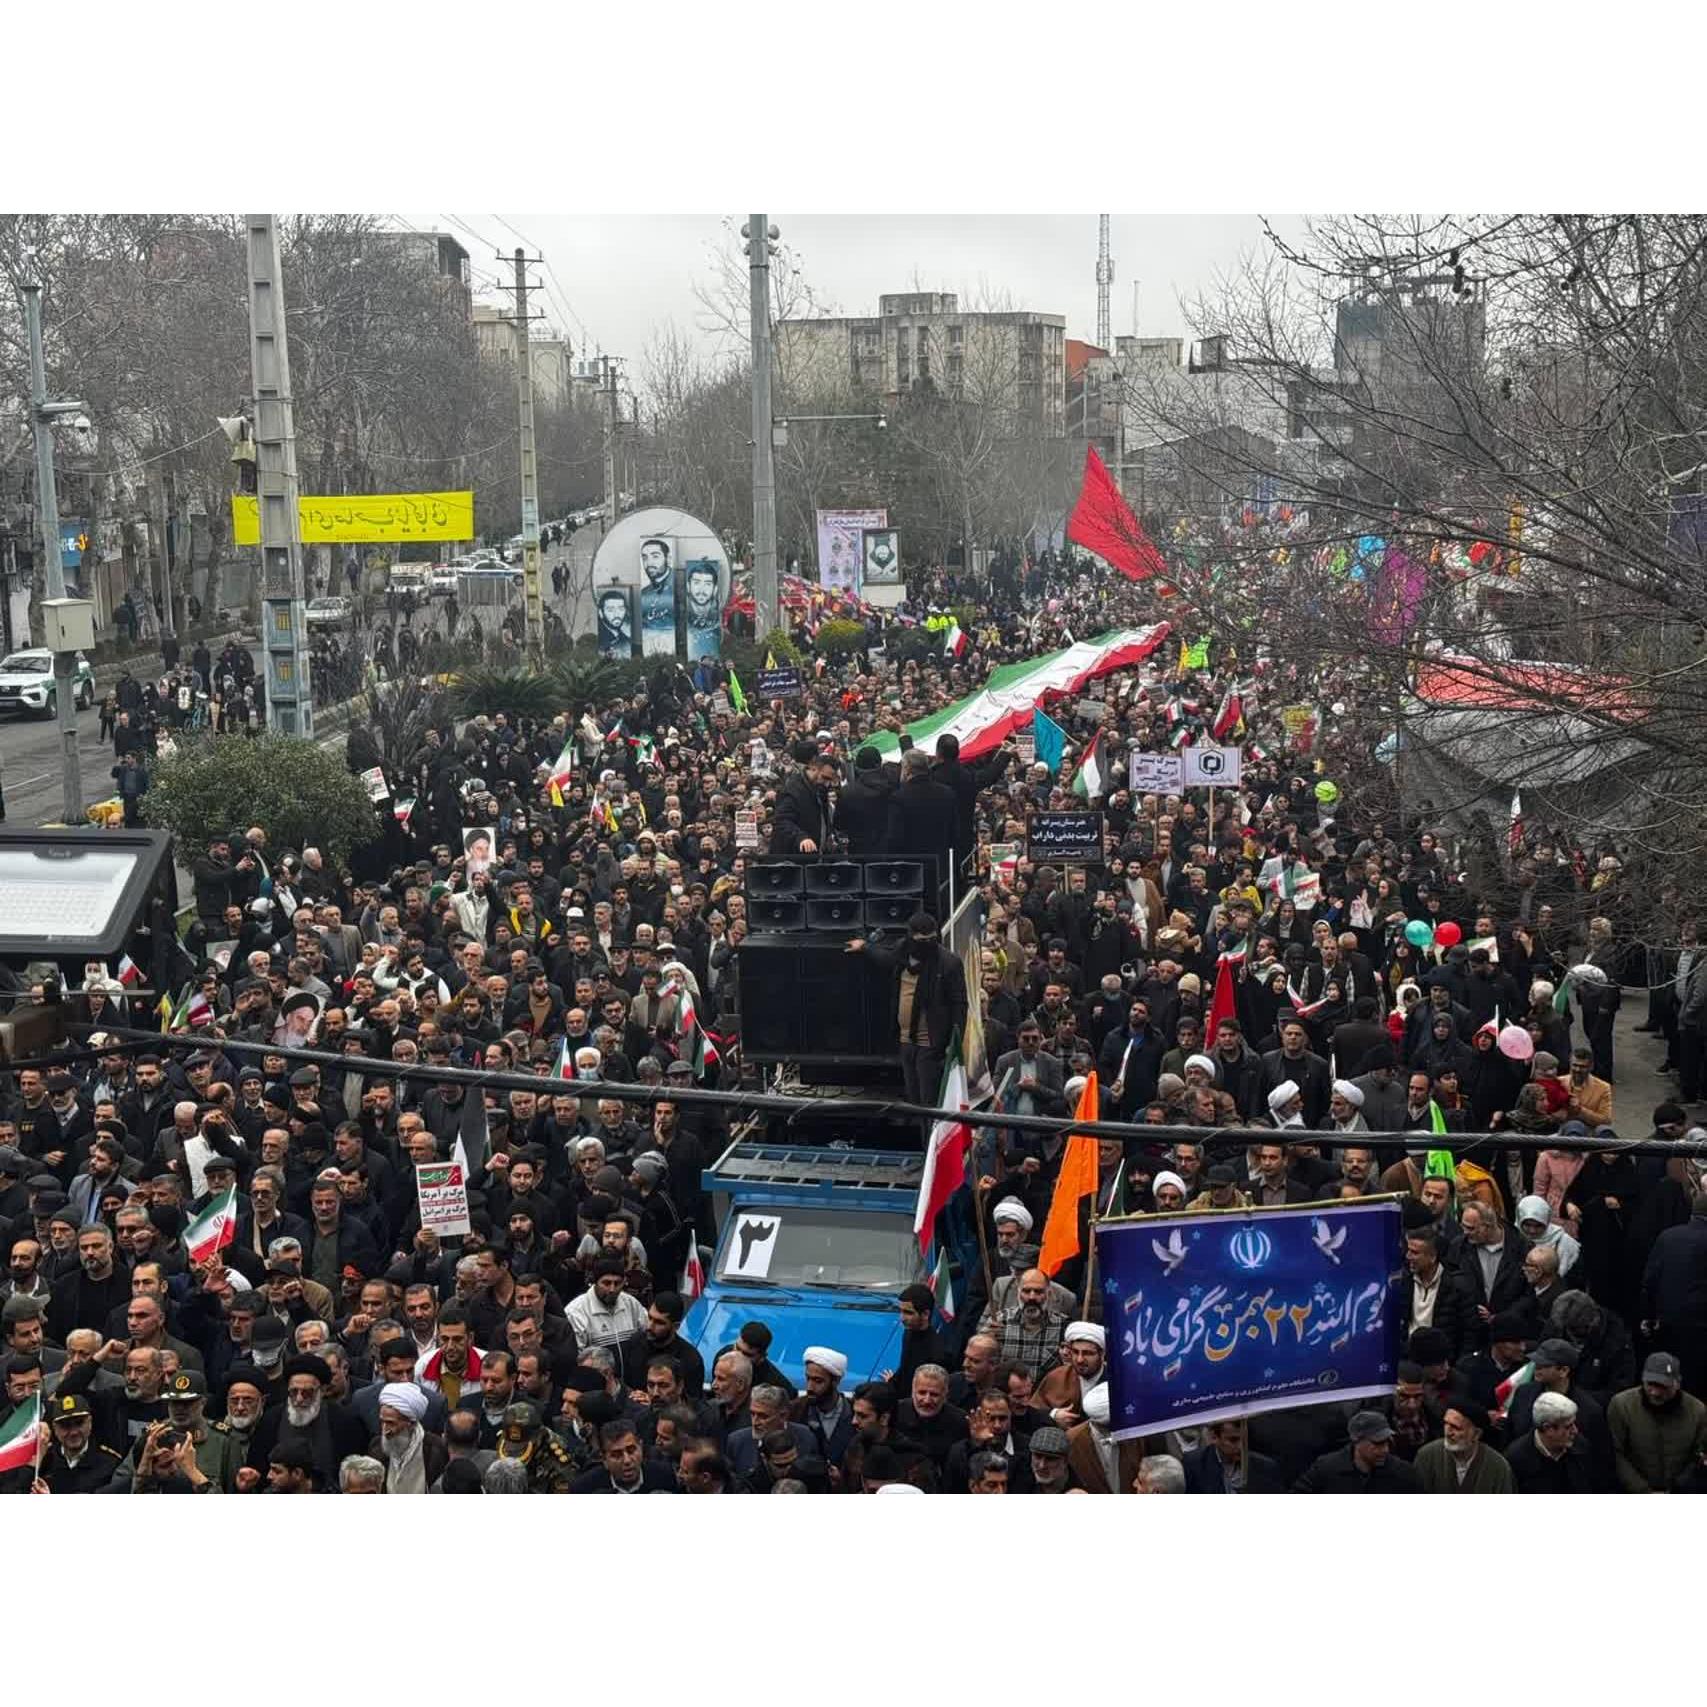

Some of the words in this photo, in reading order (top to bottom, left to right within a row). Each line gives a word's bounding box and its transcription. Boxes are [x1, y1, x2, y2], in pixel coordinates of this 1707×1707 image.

[449, 1189, 464, 1198] مرگ
[452, 1205, 466, 1214] مرگ
[739, 1219, 776, 1270] ۳
[1351, 1282, 1387, 1337] یوم
[1151, 1284, 1228, 1358] گرامی
[1203, 1287, 1274, 1362] بهمن
[1263, 1298, 1313, 1346] ۲۲
[1121, 1305, 1154, 1366] باد
[1271, 1381, 1289, 1391] علوم
[1289, 1377, 1316, 1387] دانشگاه
[1215, 1390, 1235, 1400] منابع
[1239, 1384, 1272, 1397] کشاورزی
[1171, 1397, 1192, 1407] ساری
[1192, 1393, 1216, 1404] طبیعی
